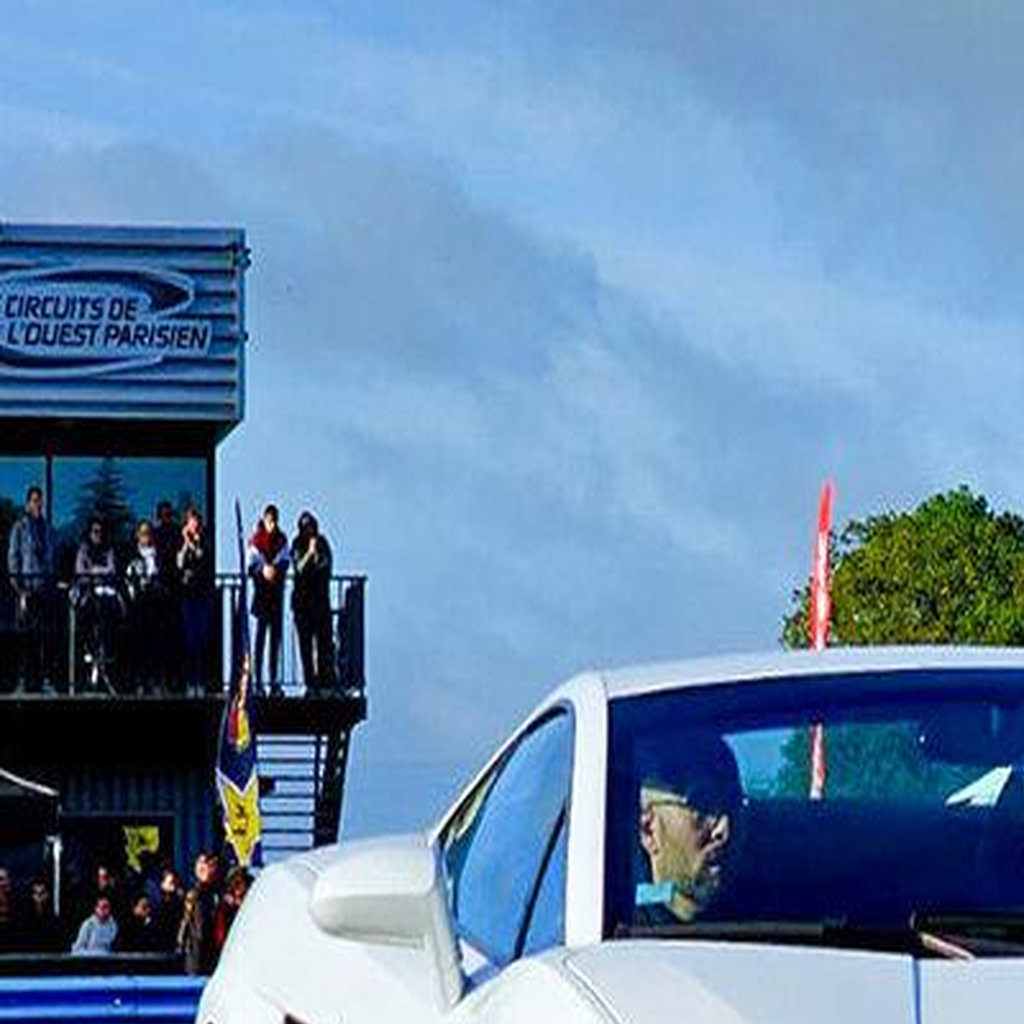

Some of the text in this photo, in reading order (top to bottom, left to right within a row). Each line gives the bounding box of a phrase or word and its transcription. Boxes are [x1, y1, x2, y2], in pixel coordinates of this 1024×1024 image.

[5, 295, 138, 321] CIRCUITS DE
[7, 323, 208, 349] L'OUEST PARISIEN
